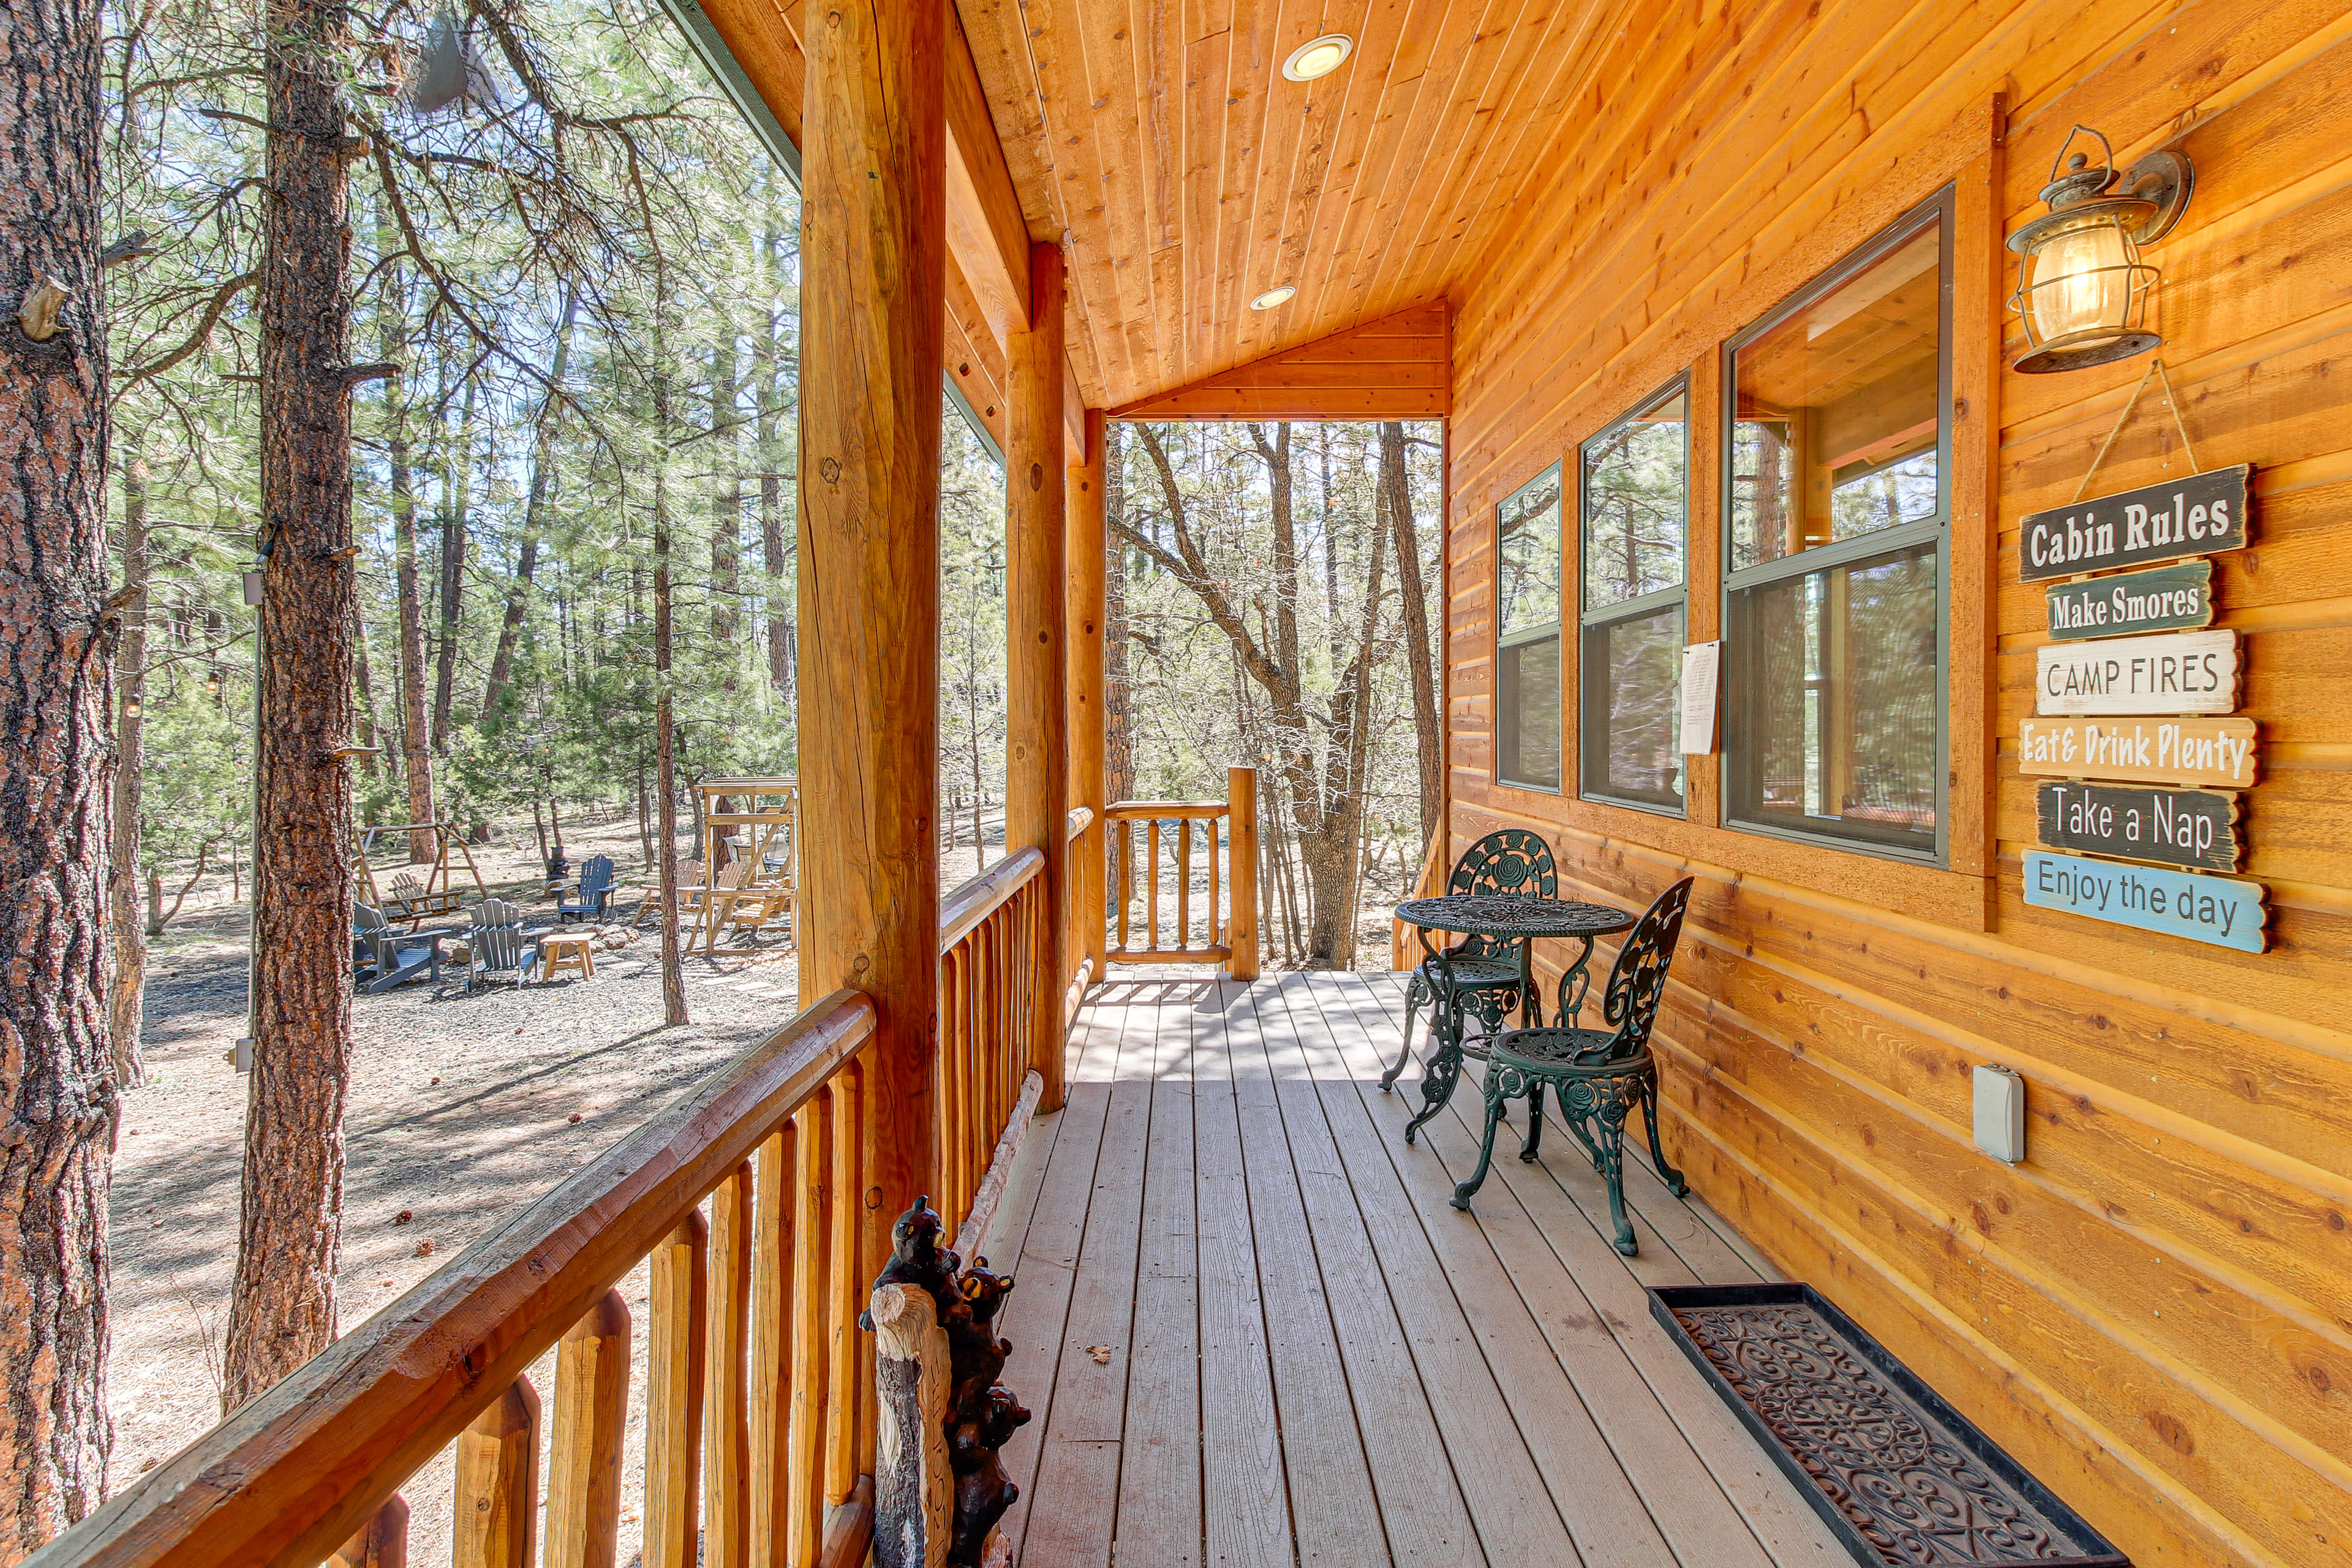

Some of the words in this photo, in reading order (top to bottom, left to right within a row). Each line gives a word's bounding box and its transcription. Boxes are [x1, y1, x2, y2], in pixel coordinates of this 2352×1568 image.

[2030, 511, 2114, 568] Cabin
[2124, 492, 2230, 551] Rules
[2052, 590, 2108, 630] Make
[2112, 586, 2199, 624] Smores
[2048, 661, 2120, 696] CAMP
[2131, 653, 2218, 693] FIRES
[2084, 725, 2150, 767] Drink
[2158, 723, 2247, 780] Plenty
[2052, 786, 2113, 839] Take
[2125, 808, 2139, 842] a
[2153, 794, 2213, 858] Nap
[2038, 861, 2112, 911] Enjoy
[2120, 875, 2167, 914] the
[2177, 884, 2237, 936] day
